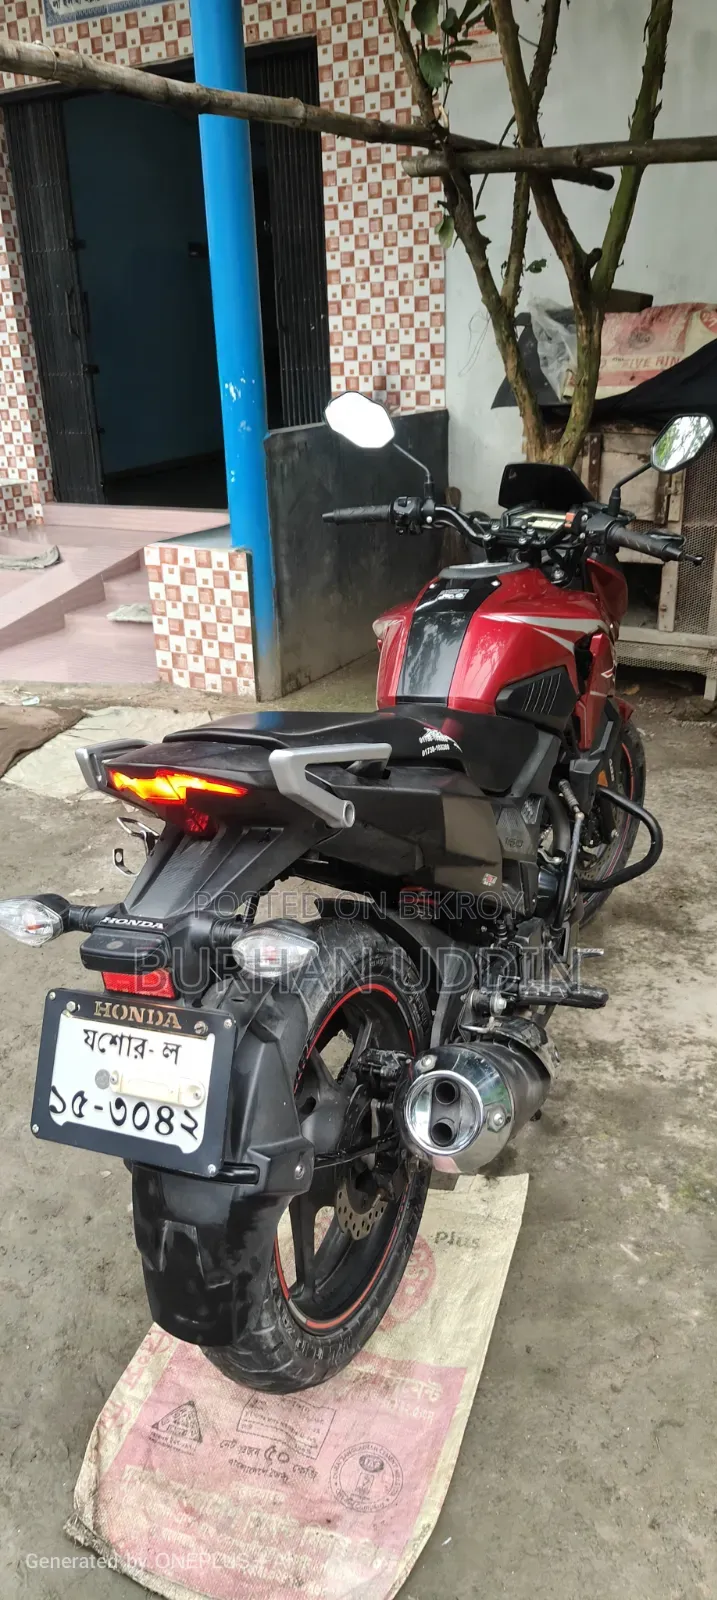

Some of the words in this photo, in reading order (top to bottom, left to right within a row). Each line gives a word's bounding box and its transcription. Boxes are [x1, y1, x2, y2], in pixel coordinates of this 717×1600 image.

[101, 916, 164, 930] HONDA
[93, 1000, 182, 1030] HONDA
[49, 1085, 200, 1140] ১৫-৩০৪২
[434, 1231, 480, 1249] Plus
